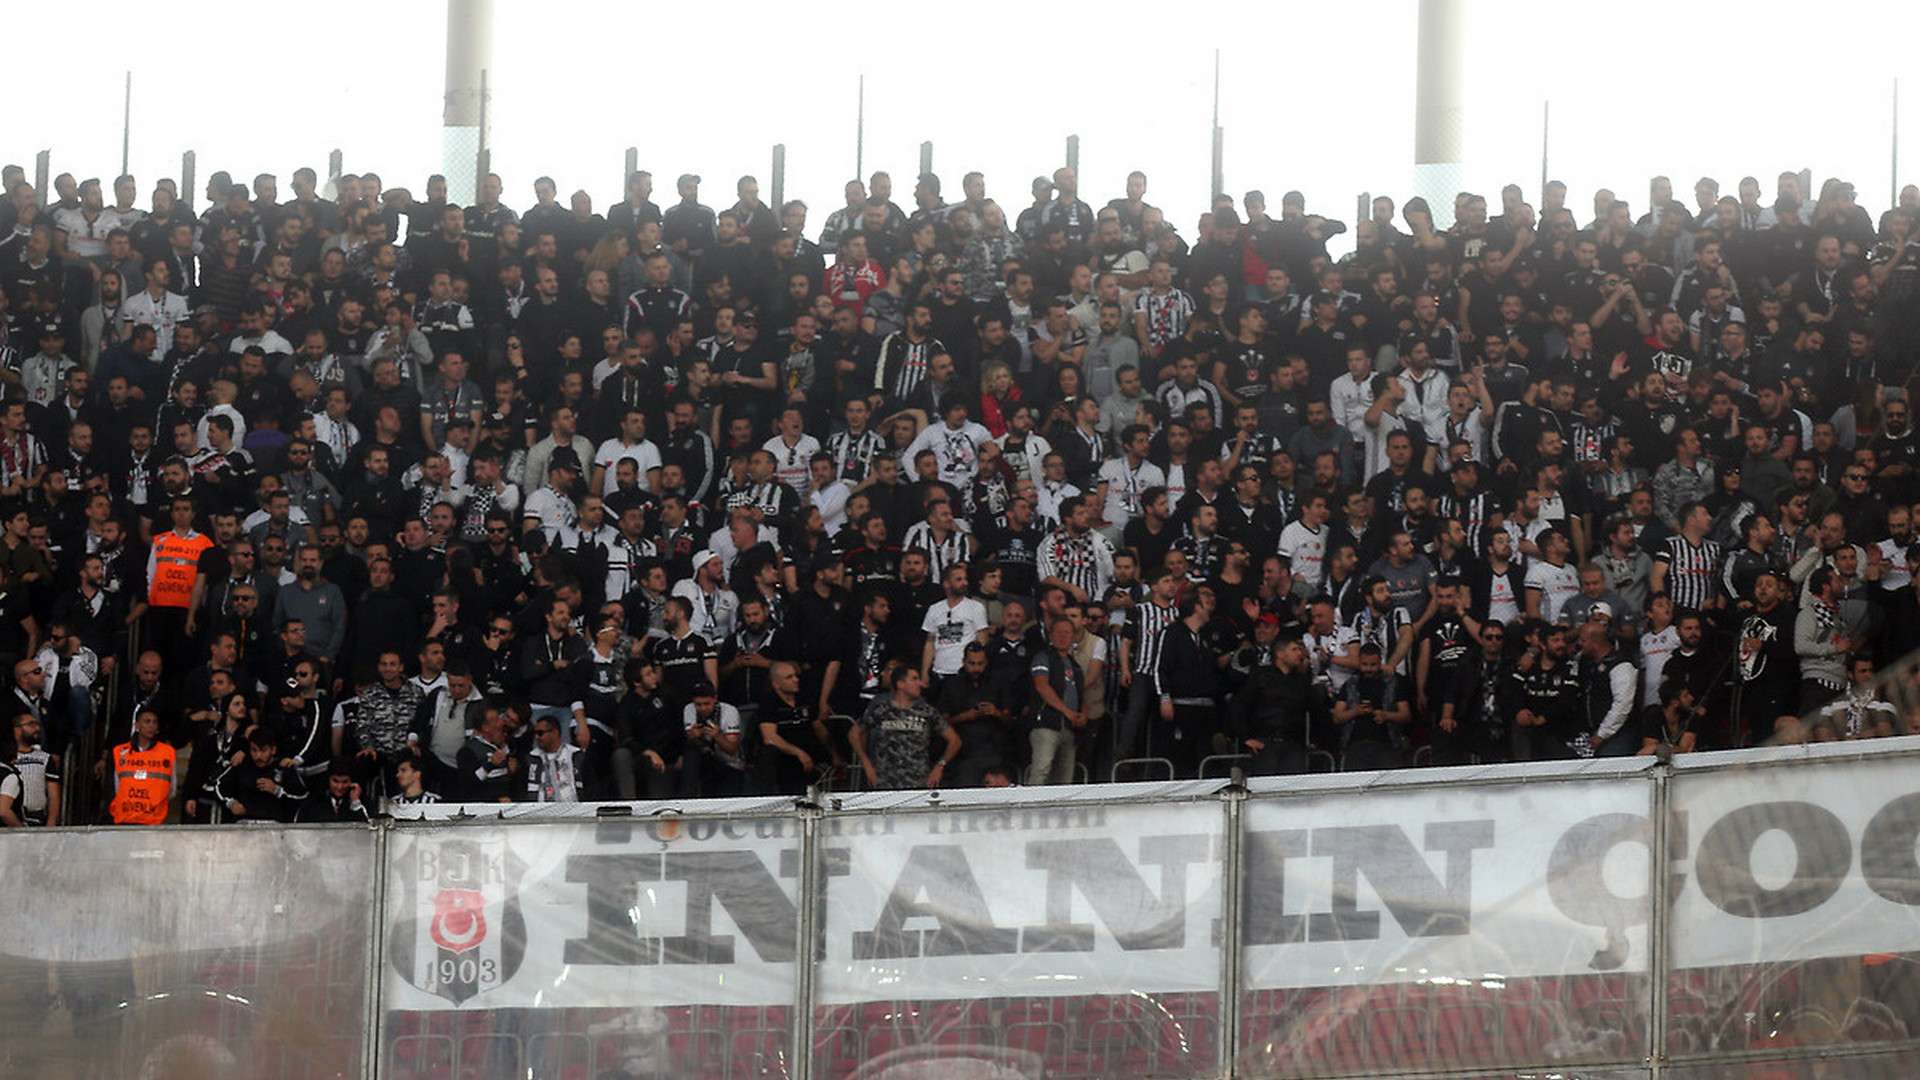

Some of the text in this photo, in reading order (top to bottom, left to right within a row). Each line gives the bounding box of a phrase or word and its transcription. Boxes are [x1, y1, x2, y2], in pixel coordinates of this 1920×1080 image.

[128, 787, 150, 800] ÖZEL
[418, 850, 505, 885] BJK
[424, 958, 497, 988] 1903
